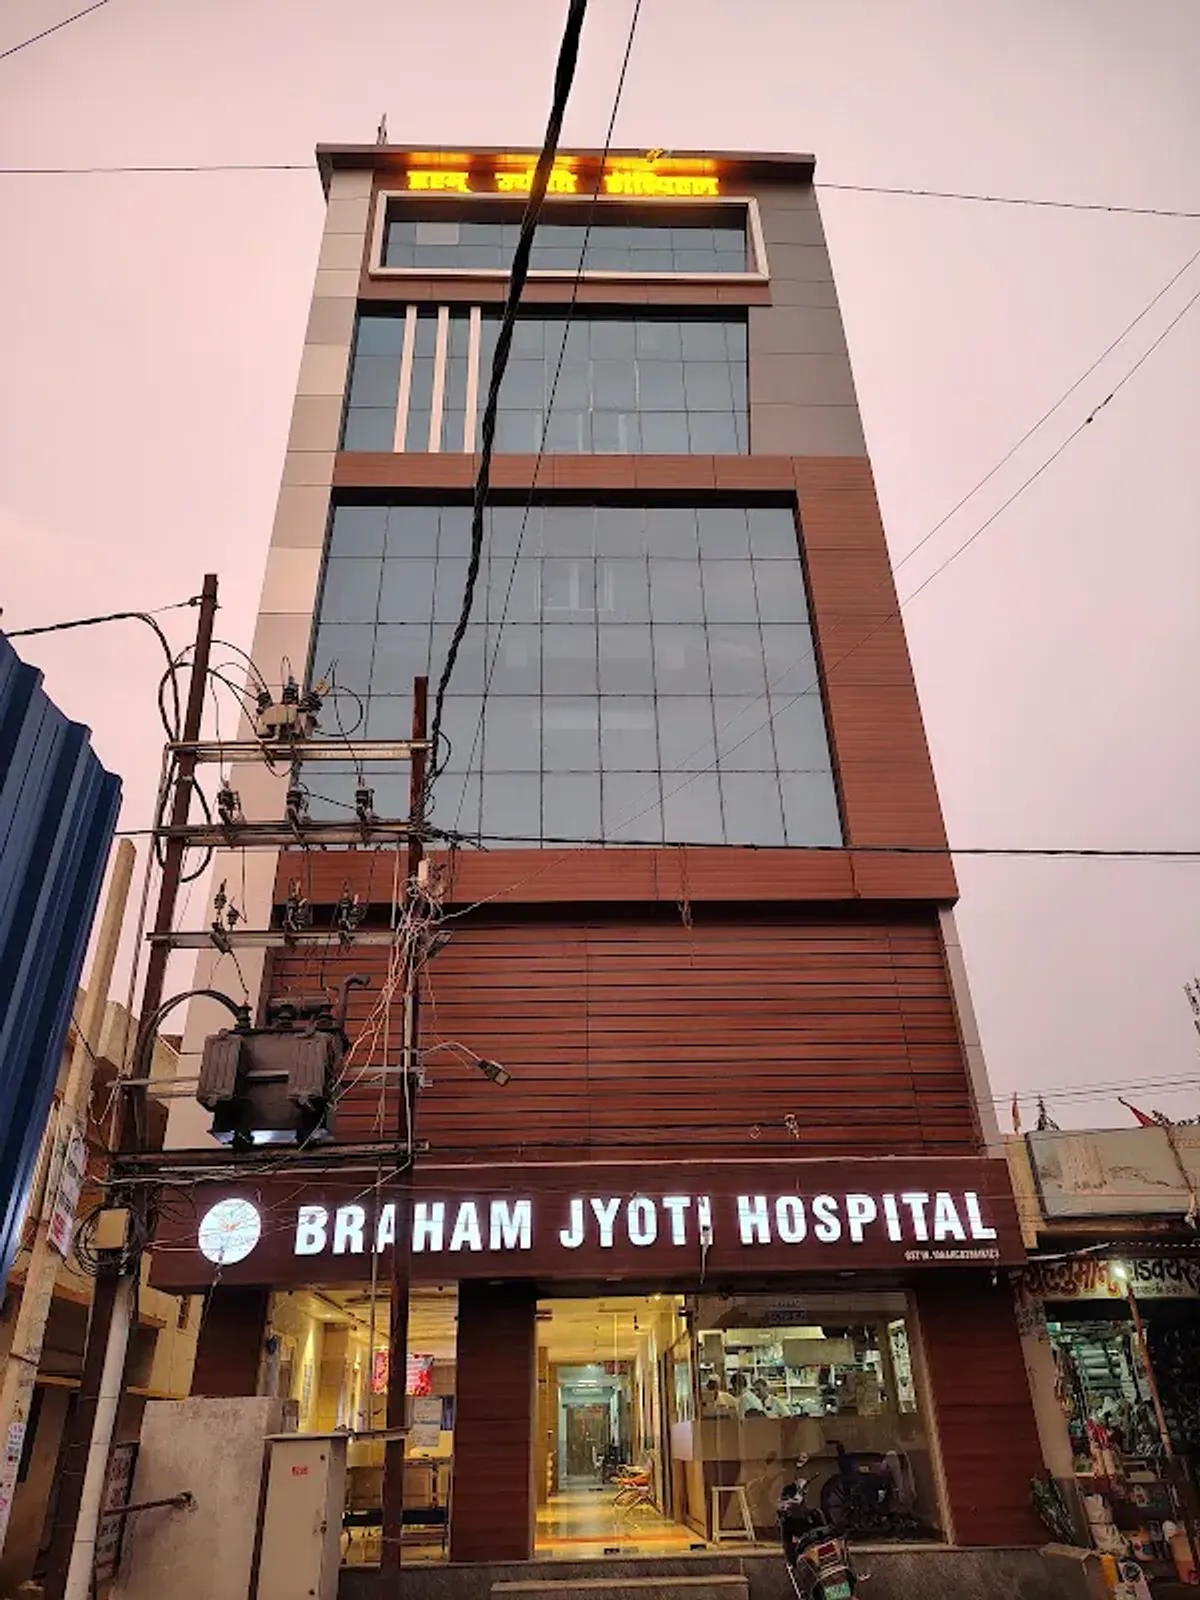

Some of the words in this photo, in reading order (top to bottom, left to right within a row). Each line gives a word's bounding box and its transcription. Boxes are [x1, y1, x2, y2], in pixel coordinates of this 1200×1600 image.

[294, 1200, 532, 1255] BRAHAM
[559, 1194, 713, 1249] JYOTI
[736, 1191, 997, 1244] HOSPITAL
